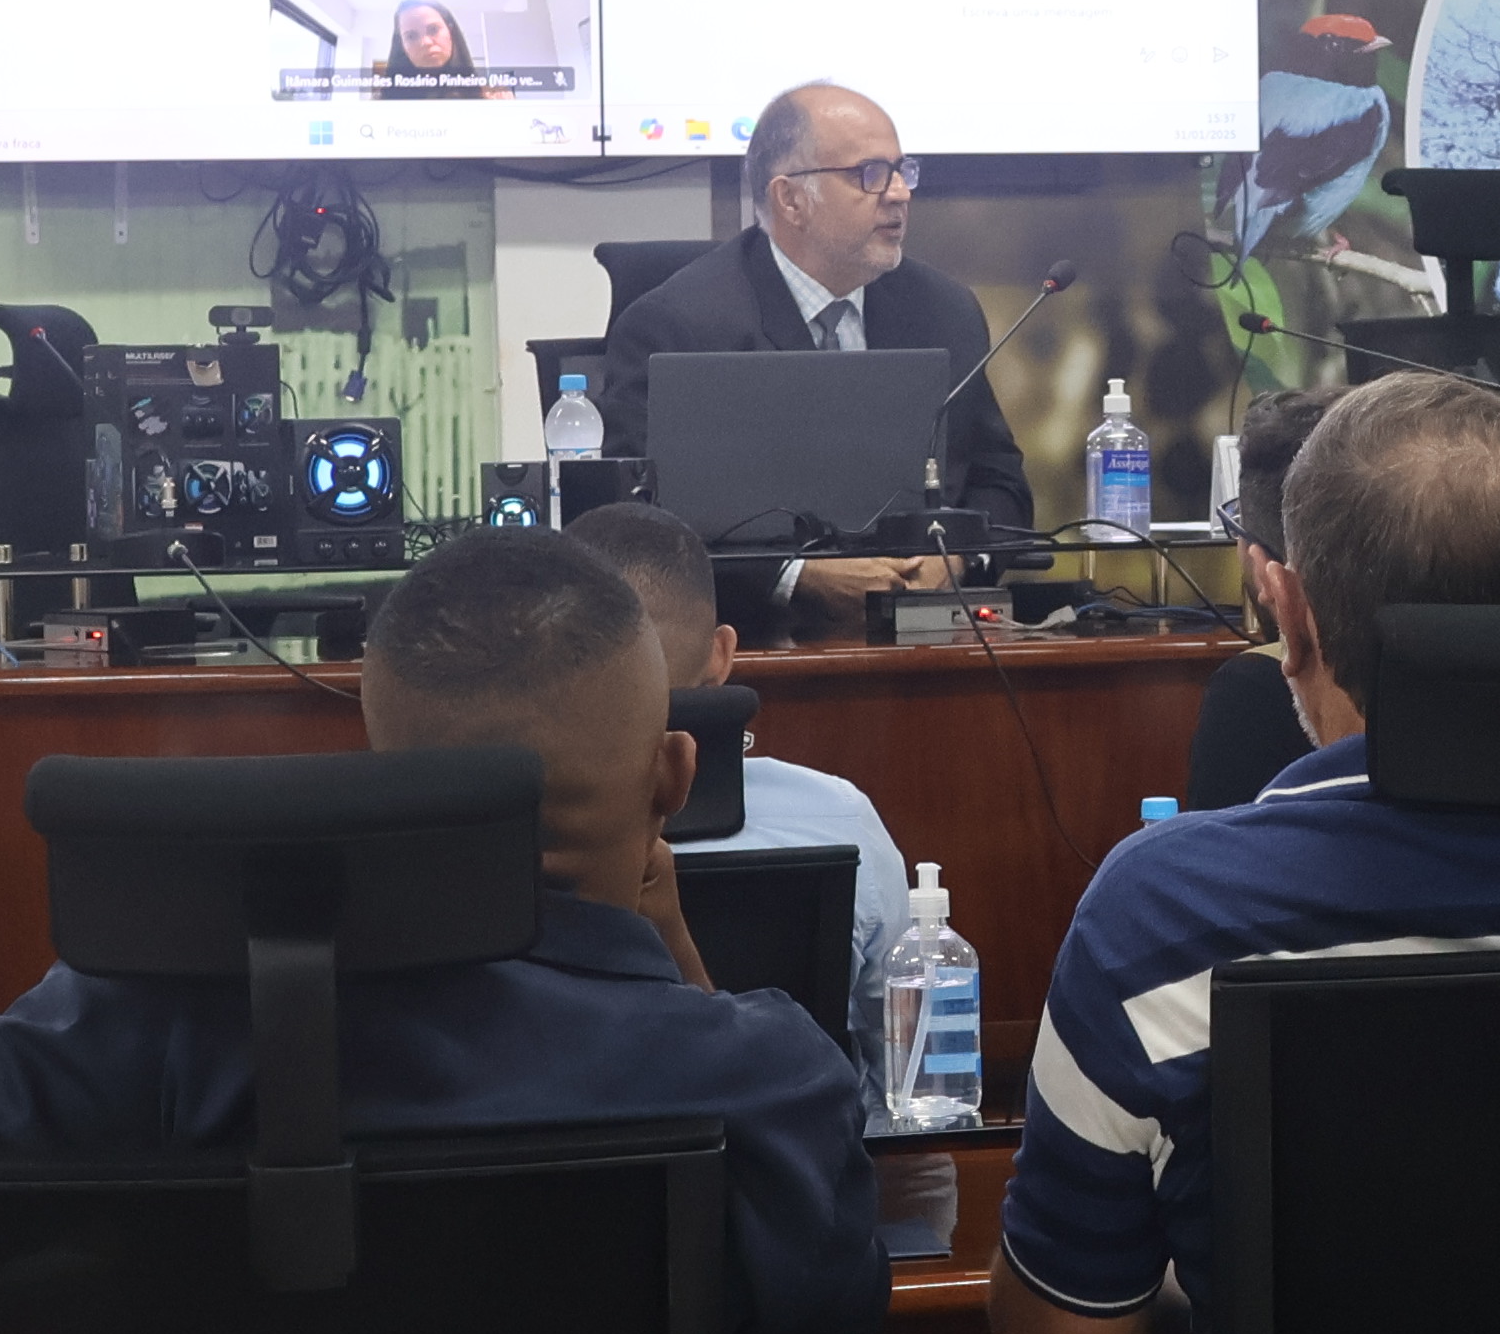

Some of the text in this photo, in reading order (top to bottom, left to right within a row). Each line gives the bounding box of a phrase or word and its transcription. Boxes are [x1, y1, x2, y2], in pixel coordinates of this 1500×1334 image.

[331, 73, 393, 88] Guimarães
[394, 73, 436, 87] Rosário
[439, 72, 487, 87] Pinheiro
[489, 72, 517, 88] (Não
[1207, 113, 1237, 124] 15:37
[387, 125, 448, 140] Pesquisar
[1174, 129, 1237, 141] 31/01/2025
[12, 137, 41, 150] fraca
